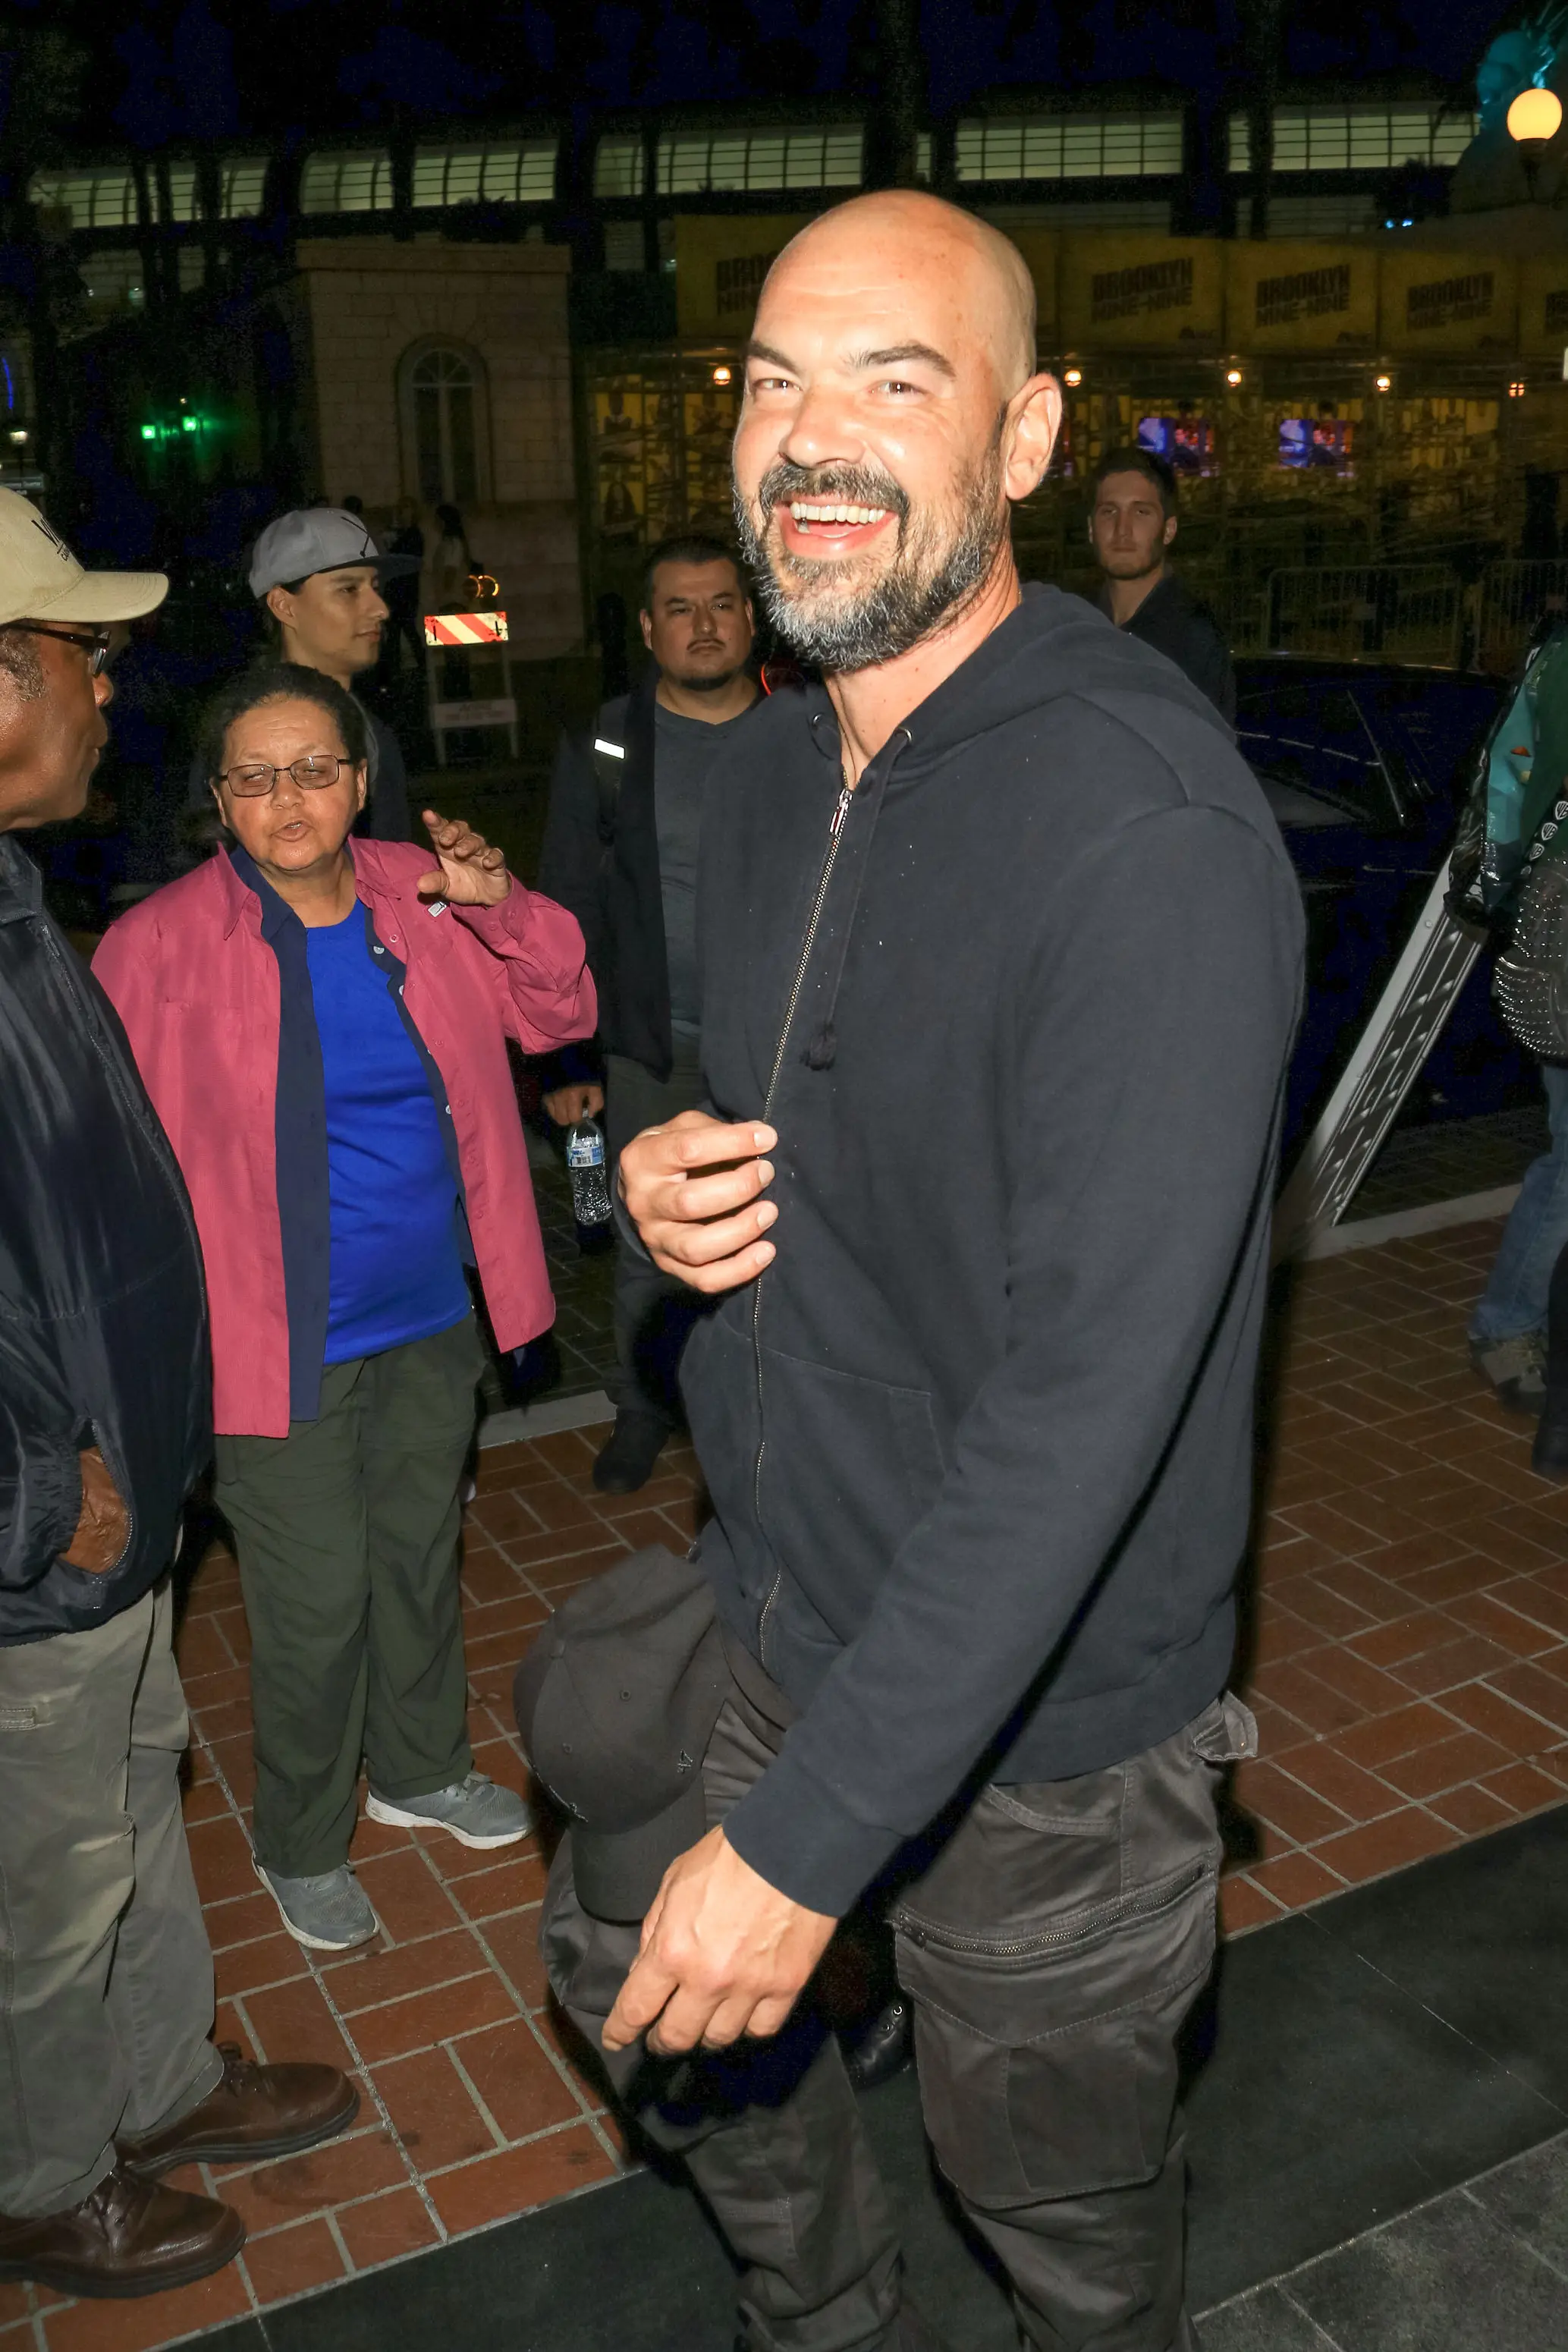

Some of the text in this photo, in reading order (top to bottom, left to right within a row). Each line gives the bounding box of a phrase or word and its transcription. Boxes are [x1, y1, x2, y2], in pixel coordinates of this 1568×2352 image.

[1091, 256, 1194, 303] BROOKLYN
[1255, 264, 1350, 309] BROOKLYN
[1407, 270, 1494, 310] BROOKLYN
[1091, 285, 1193, 323] NINE-NINE
[1255, 291, 1350, 328] NINE-NINE
